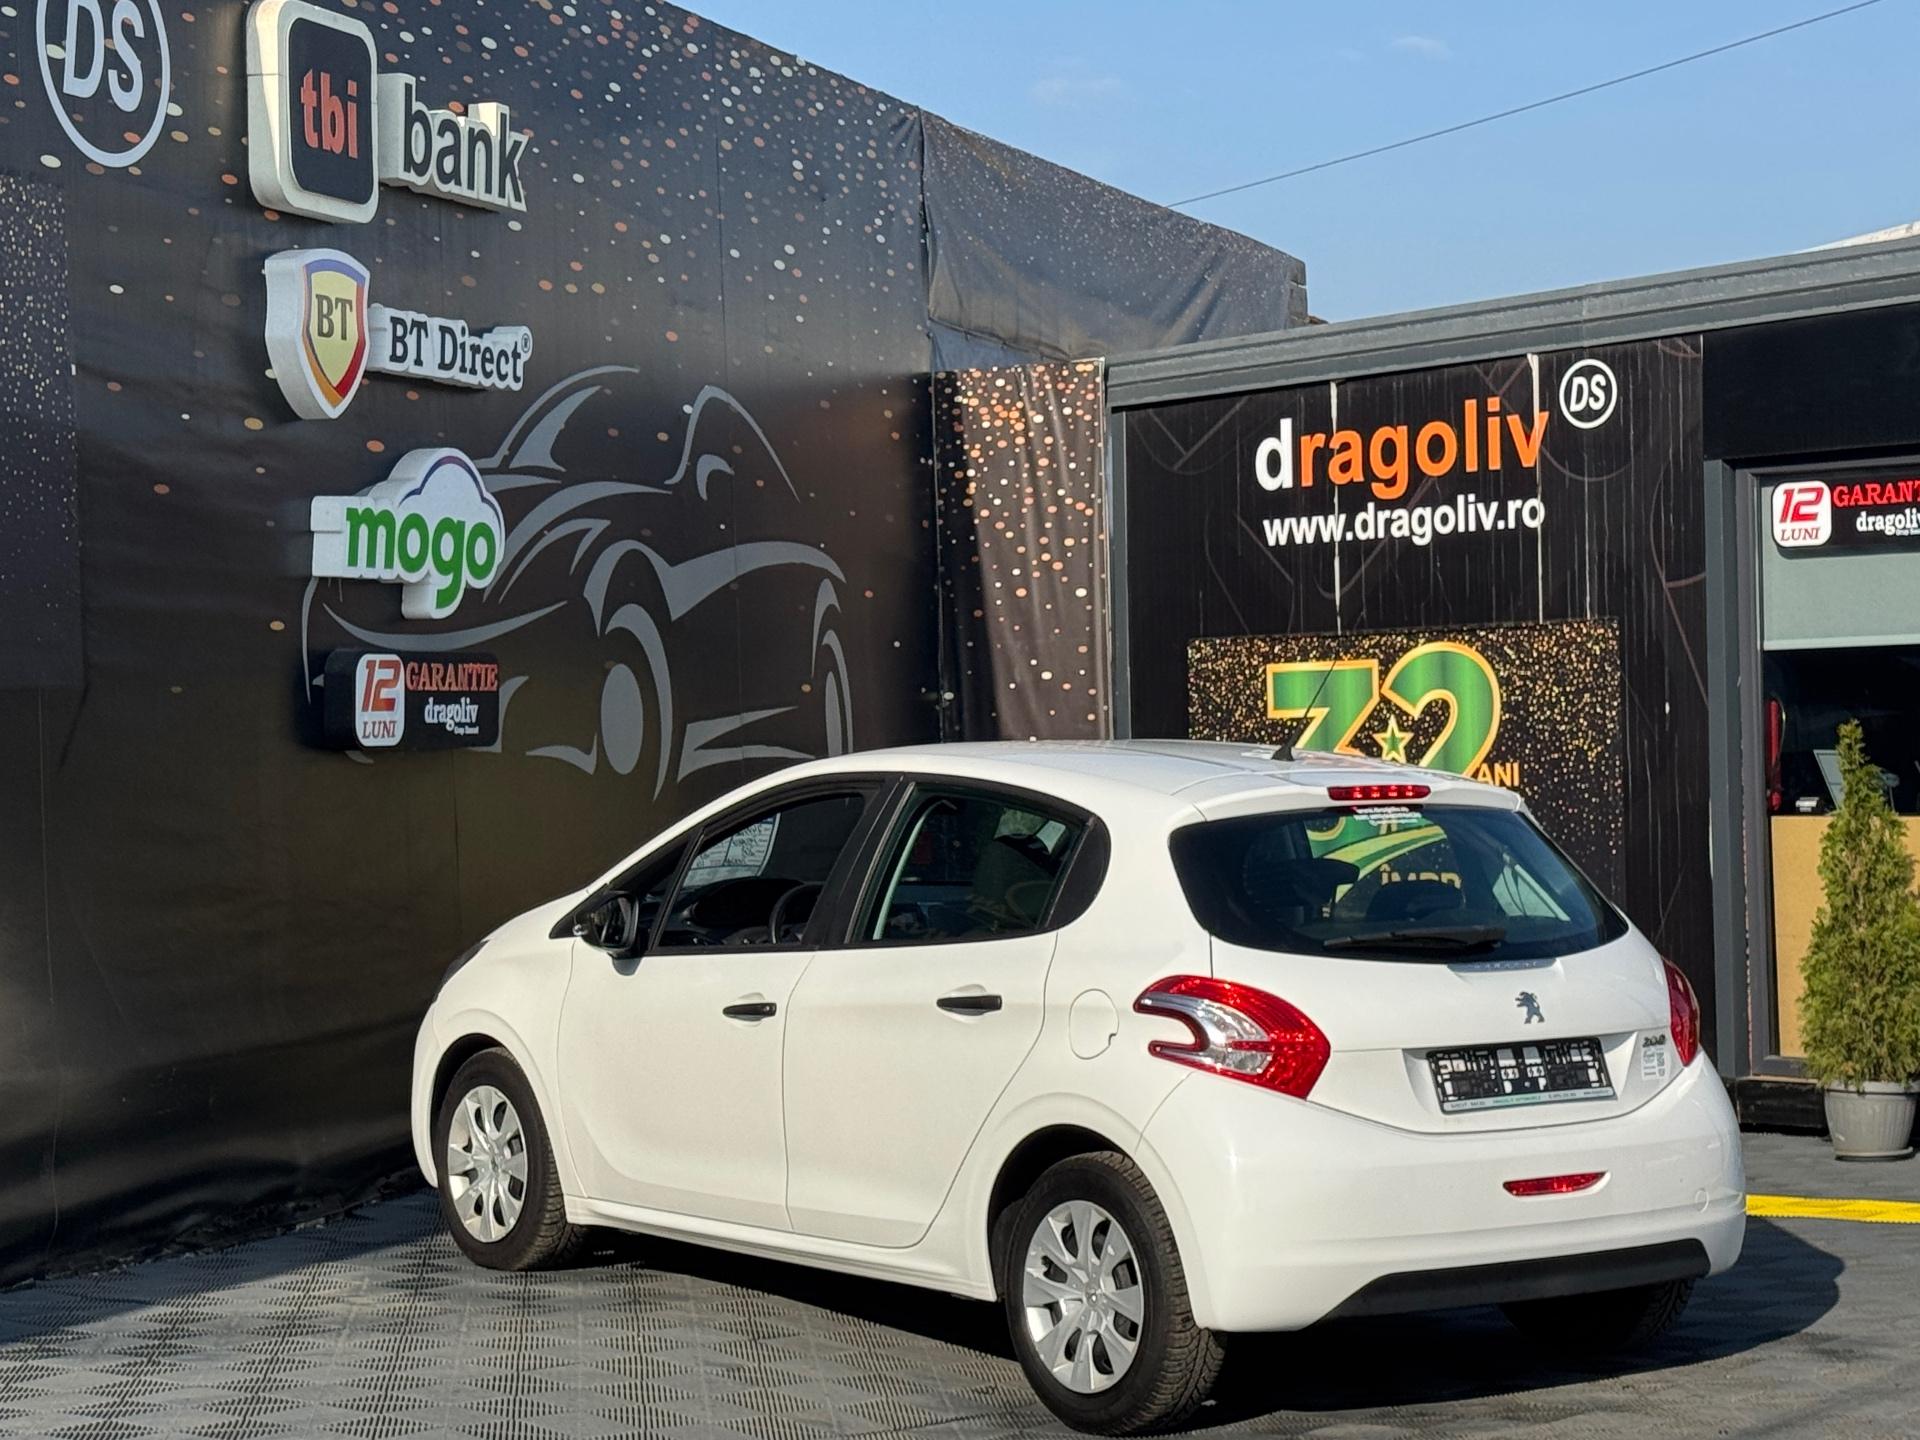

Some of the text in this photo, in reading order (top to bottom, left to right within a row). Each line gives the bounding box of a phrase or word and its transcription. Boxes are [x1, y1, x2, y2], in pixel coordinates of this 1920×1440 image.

[63, 0, 145, 112] DS
[301, 69, 523, 203] tbi bank
[315, 293, 353, 341] BT
[389, 315, 429, 367] BT
[1569, 373, 1607, 413] DS
[1255, 396, 1550, 500] dragoliv
[1263, 493, 1546, 546] www.dragoliv.ro
[1779, 487, 1824, 523] 12
[346, 506, 496, 609] mogo
[1780, 527, 1820, 542] LUNI
[361, 660, 400, 712] 12
[405, 661, 498, 691] GARANTIE
[361, 720, 397, 739] LUNI
[424, 696, 479, 731] dragoliv
[1476, 761, 1520, 788] ANI
